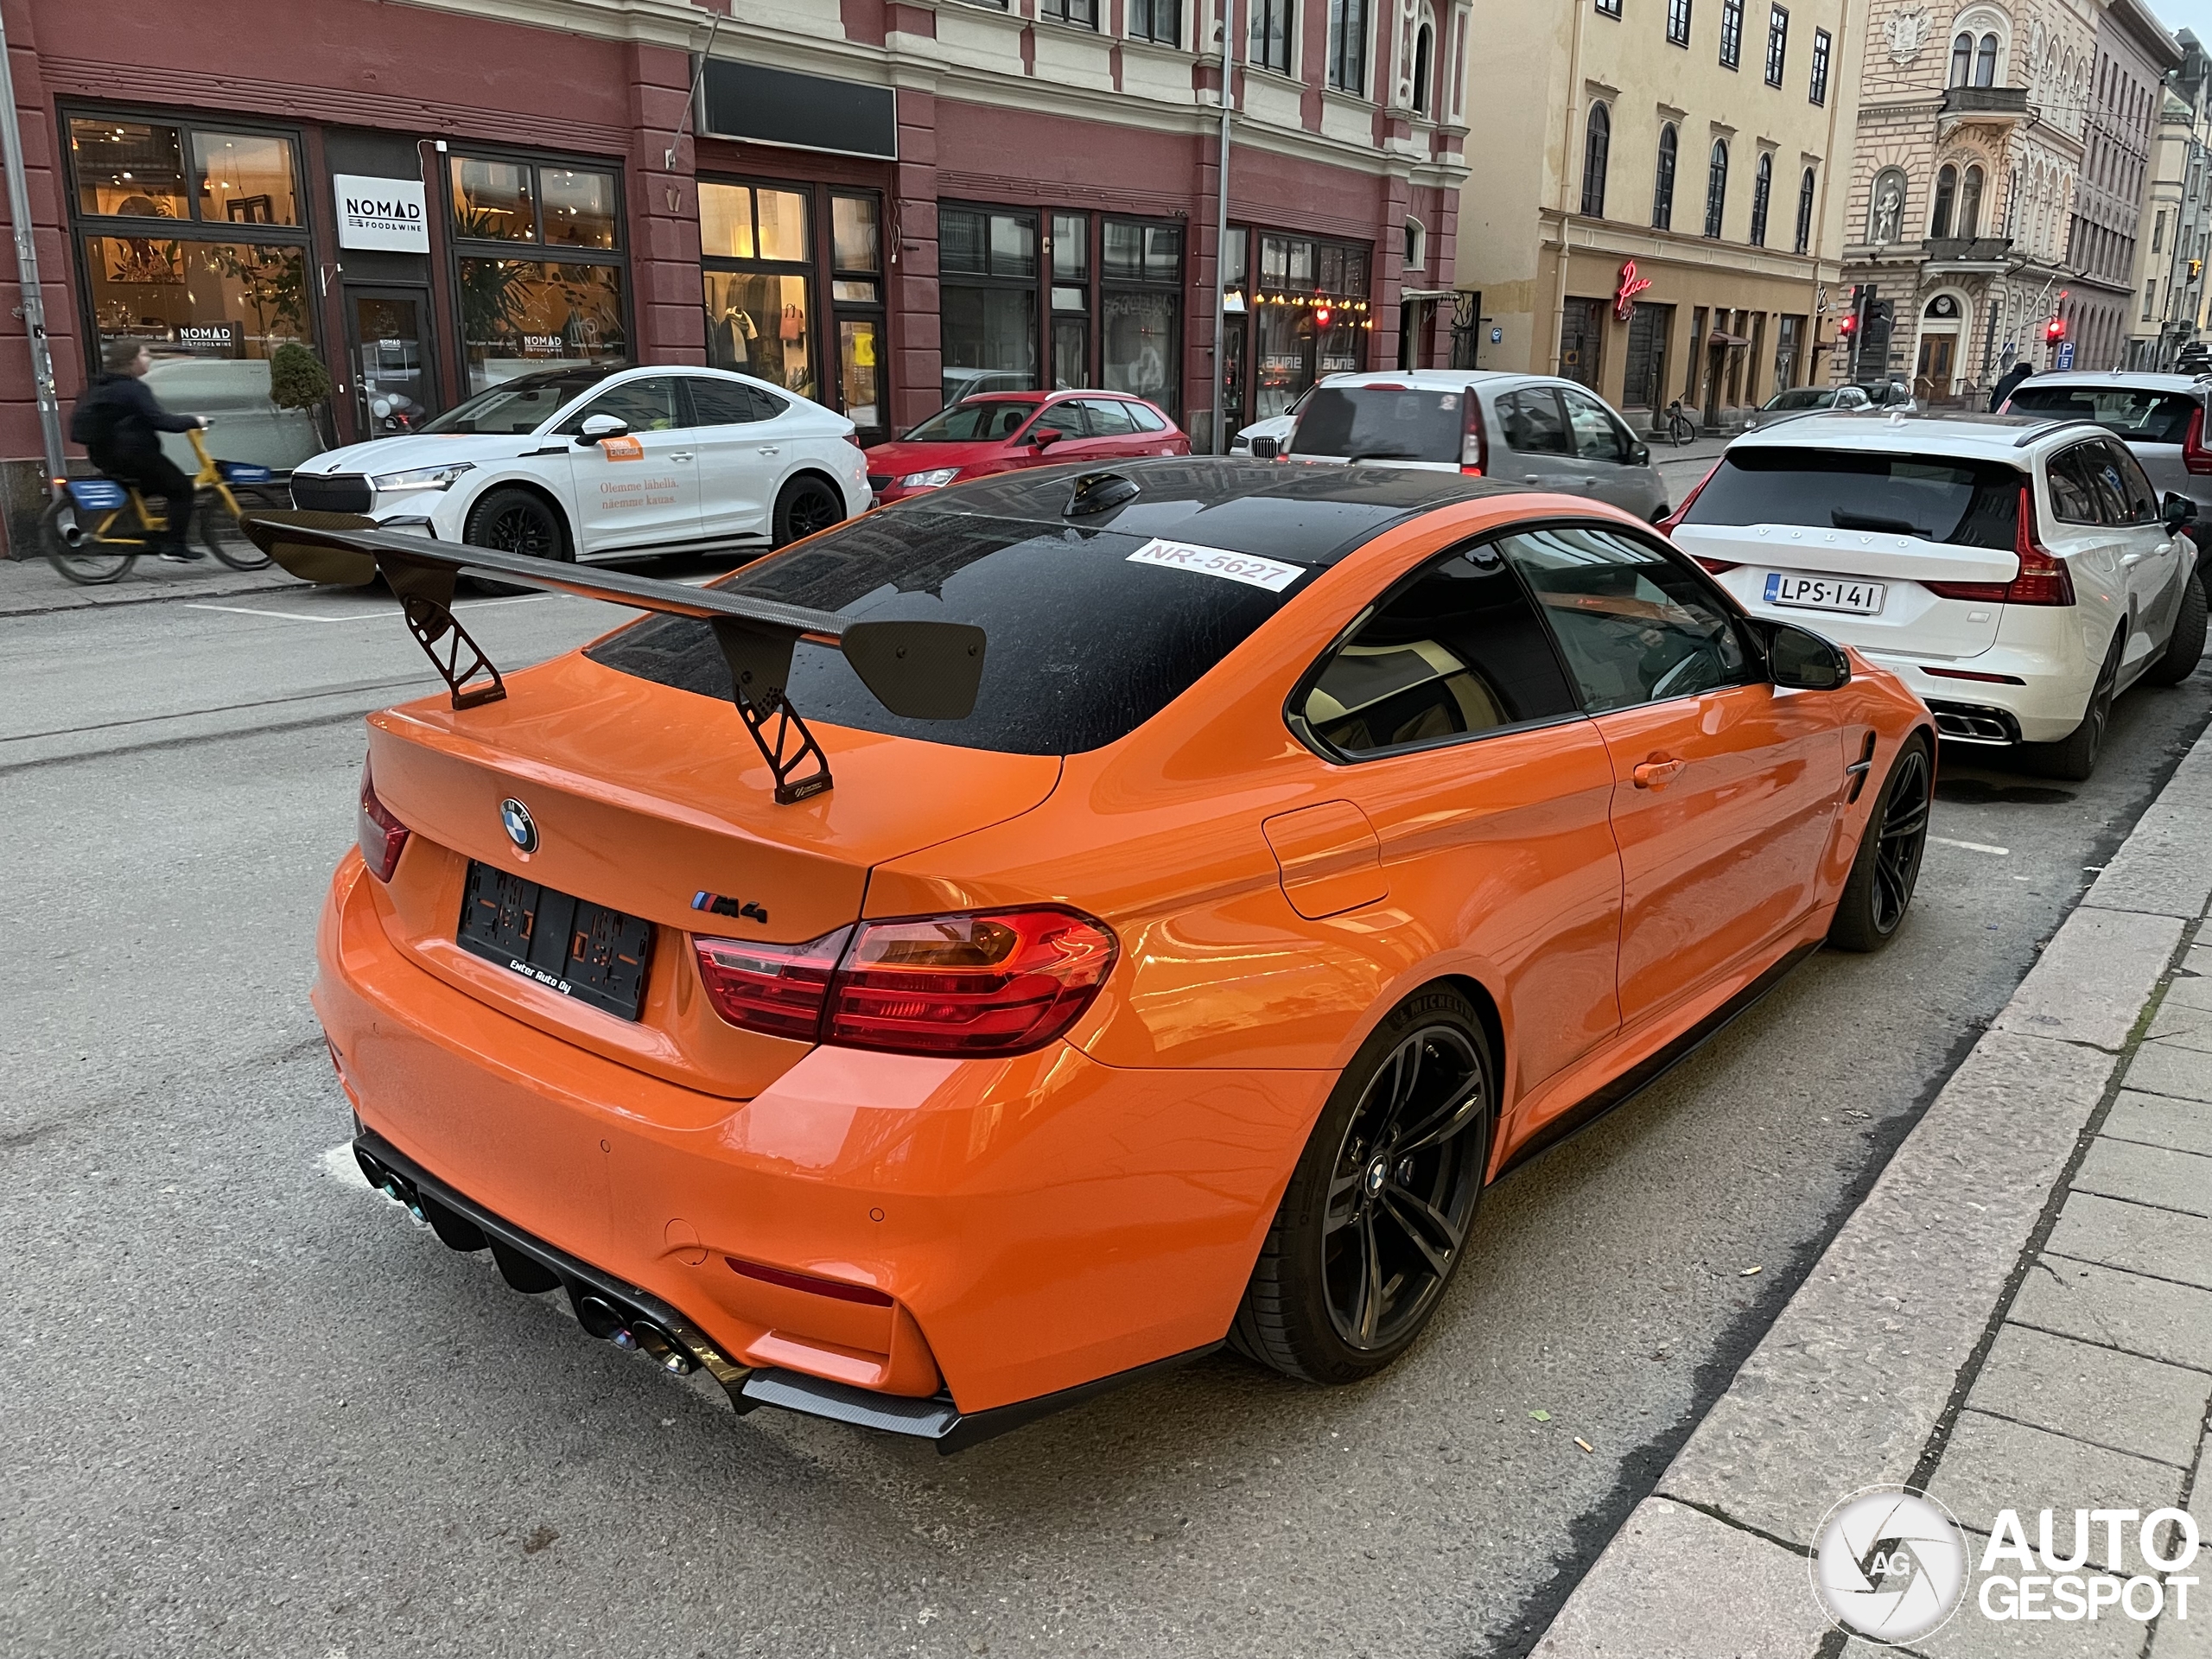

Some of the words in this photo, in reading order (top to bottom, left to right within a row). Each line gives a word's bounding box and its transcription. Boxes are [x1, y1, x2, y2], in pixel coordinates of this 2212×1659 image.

[346, 198, 420, 219] NOMAD
[180, 327, 232, 339] NOMAD
[524, 335, 562, 346] NOMAD
[2062, 343, 2073, 355] P
[1267, 356, 1302, 369] aune
[1323, 358, 1355, 370] aune
[610, 448, 640, 456] ENERGIA
[600, 481, 642, 493] Olemme
[601, 498, 644, 509] näemme
[646, 494, 677, 505] kauas.
[1758, 528, 1909, 548] VOLVO
[1141, 544, 1287, 582] NR-5627
[1781, 578, 1874, 607] LPS-141
[501, 801, 529, 823] BMW
[709, 893, 768, 925] M4
[535, 970, 558, 987] Auto
[558, 980, 572, 995] Oy
[1410, 994, 1473, 1020] MICHELIN
